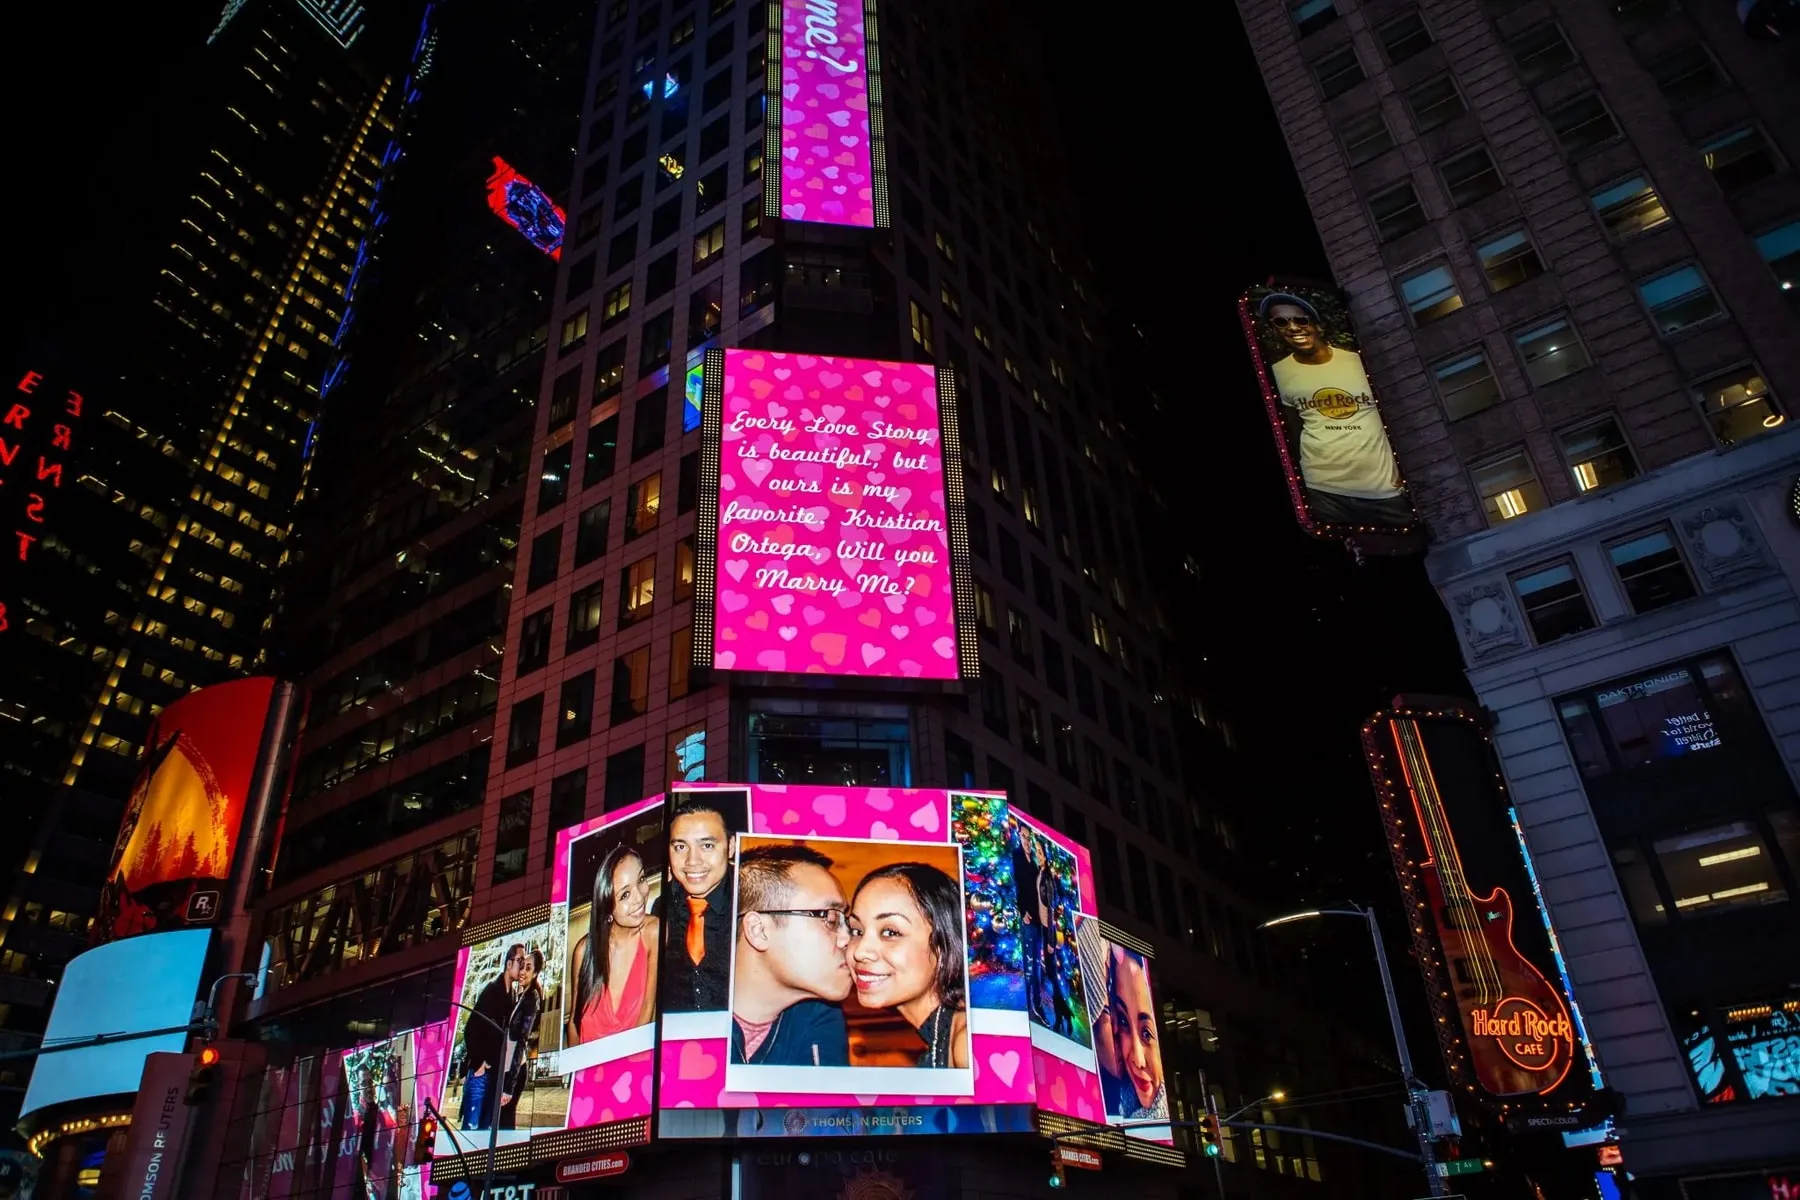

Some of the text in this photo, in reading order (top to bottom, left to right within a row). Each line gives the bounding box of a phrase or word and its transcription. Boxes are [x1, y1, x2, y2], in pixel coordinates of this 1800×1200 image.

[1298, 391, 1372, 410] Hard Rock
[729, 411, 933, 445] Every Love Story
[737, 440, 928, 471] is beautiful, but
[768, 477, 900, 503] ours is my
[722, 501, 945, 533] favorite. Kristian
[731, 533, 938, 567] Ortega, Will you
[755, 568, 916, 597] Marry Me?
[1597, 669, 1689, 702] DAKTRONICS
[1471, 1009, 1573, 1042] Hard Rock
[1514, 1043, 1545, 1056] CAFE
[811, 1115, 923, 1128] THOMSN REUTERS
[563, 1158, 624, 1176] BRANDED CITIES.com
[757, 1150, 842, 1170] eurpa
[480, 1183, 535, 1200] T&T
